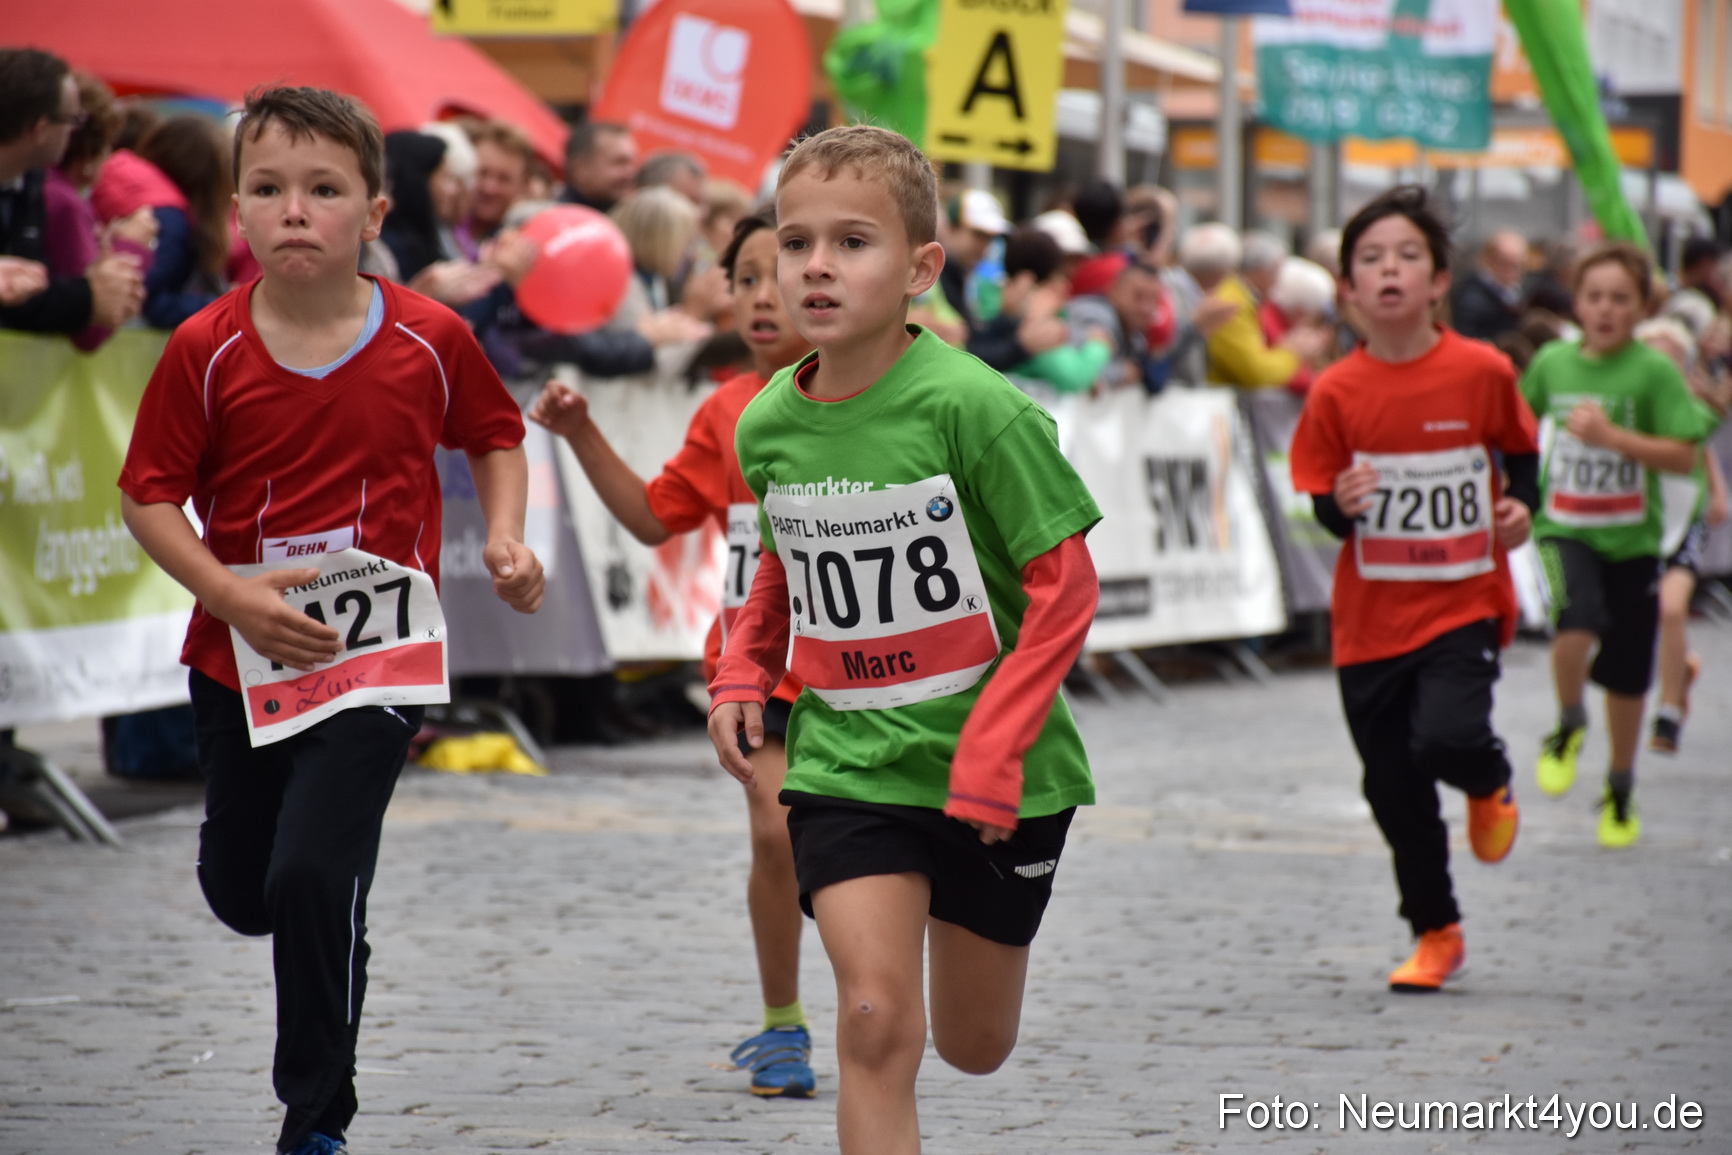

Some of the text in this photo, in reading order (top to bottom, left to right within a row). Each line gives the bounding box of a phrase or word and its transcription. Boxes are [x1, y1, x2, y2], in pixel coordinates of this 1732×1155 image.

[961, 30, 1025, 120] A
[1559, 456, 1638, 491] 7020
[772, 515, 814, 538] PARTL
[816, 509, 919, 538] Neumarkt
[1375, 480, 1479, 531] 7208
[286, 541, 328, 558] DEHN
[292, 558, 389, 595] Neumarkt
[790, 535, 961, 629] 7078
[966, 597, 978, 611] K
[841, 650, 917, 681] Marc
[295, 670, 367, 713] Luis
